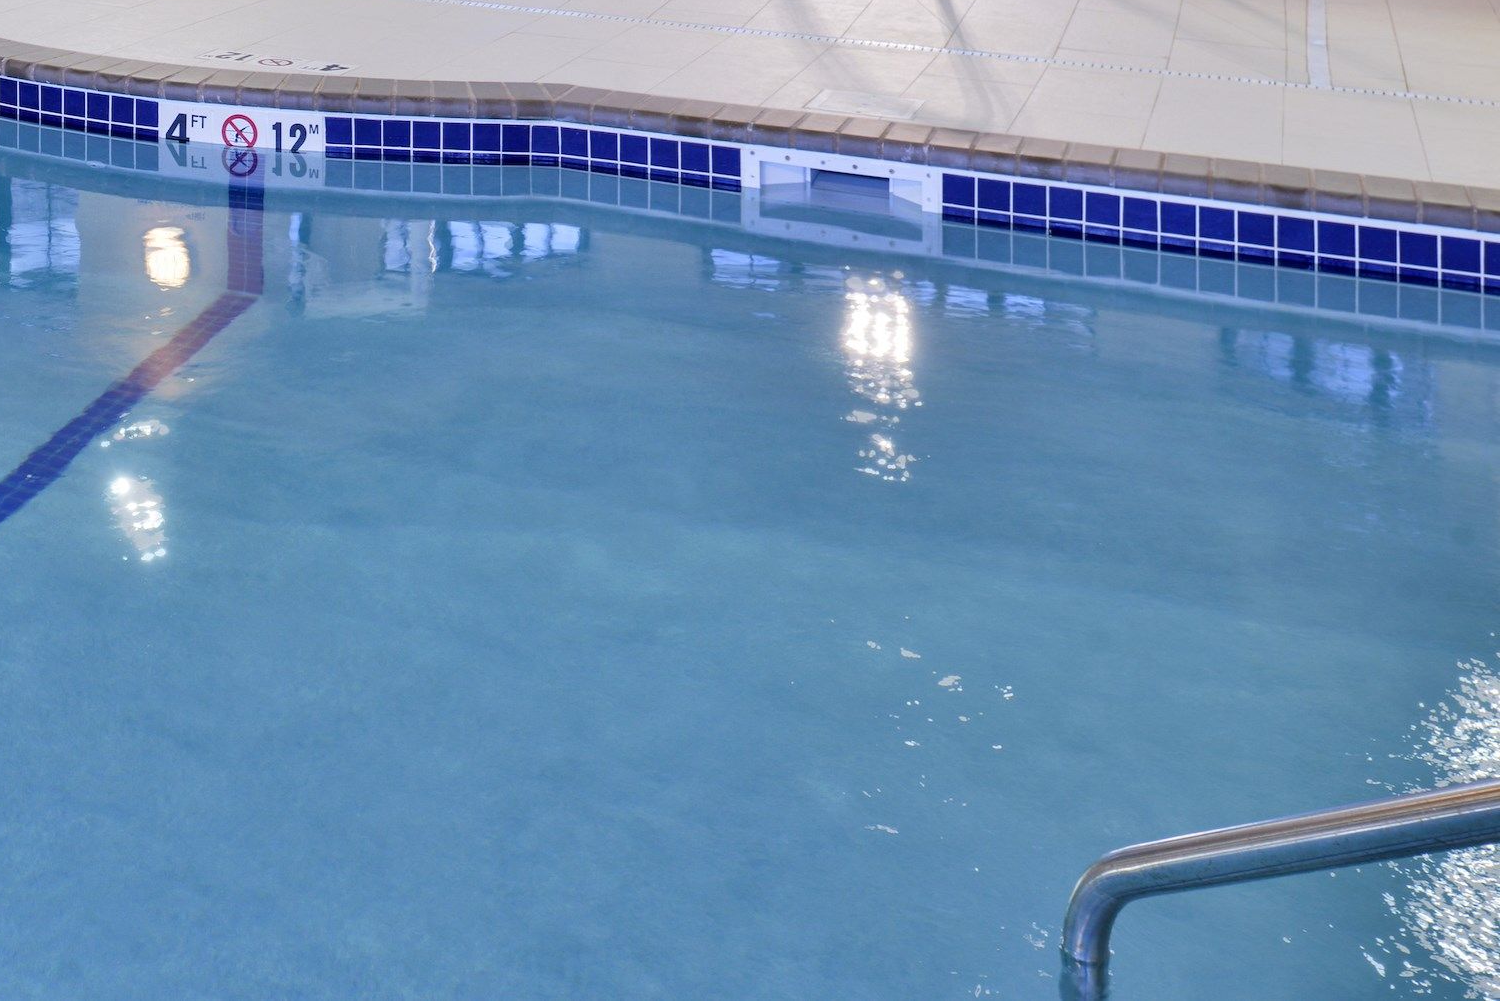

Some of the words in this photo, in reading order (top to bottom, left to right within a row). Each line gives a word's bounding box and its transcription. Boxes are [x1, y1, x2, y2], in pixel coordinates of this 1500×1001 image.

[165, 113, 190, 143] 4
[191, 114, 207, 129] FT
[272, 122, 308, 153] 12
[309, 124, 319, 135] M
